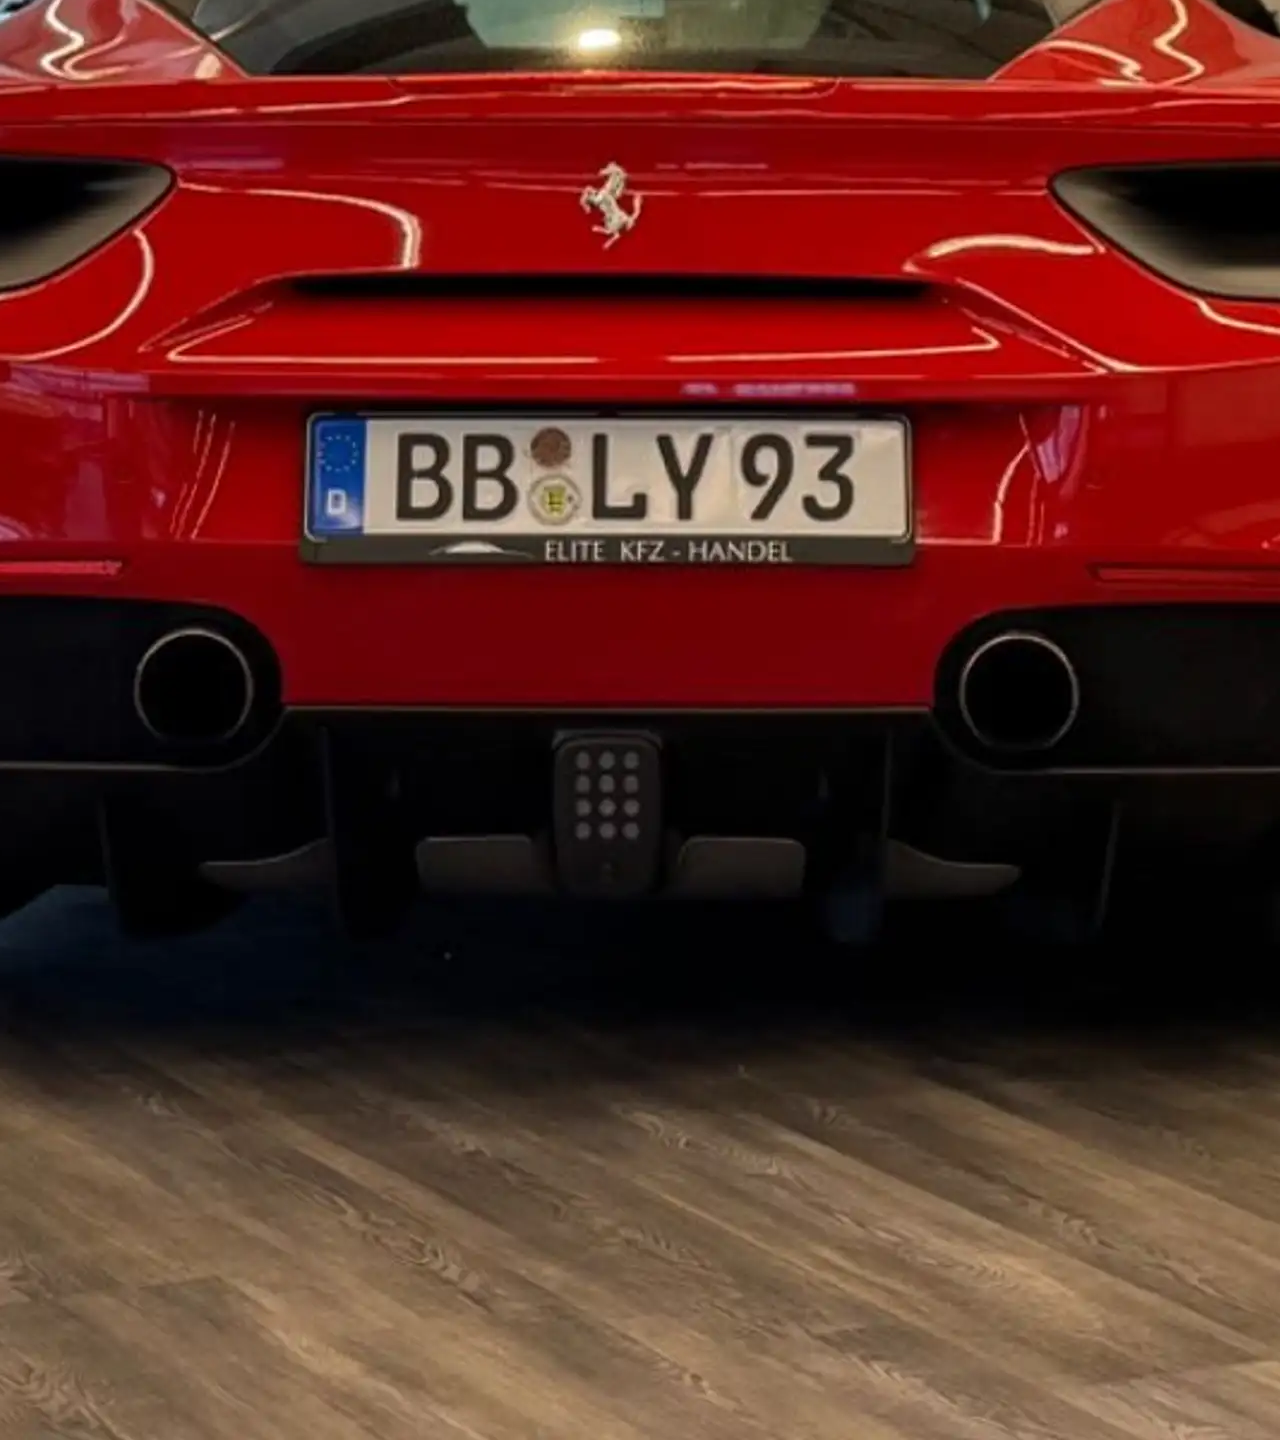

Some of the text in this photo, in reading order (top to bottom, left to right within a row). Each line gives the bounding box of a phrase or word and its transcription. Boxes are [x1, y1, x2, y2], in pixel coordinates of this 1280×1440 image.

[396, 432, 855, 522] BB LY 93
[326, 489, 347, 516] D
[544, 539, 605, 562] ELITE
[620, 539, 666, 562] KFZ
[687, 539, 794, 562] HANDEL
